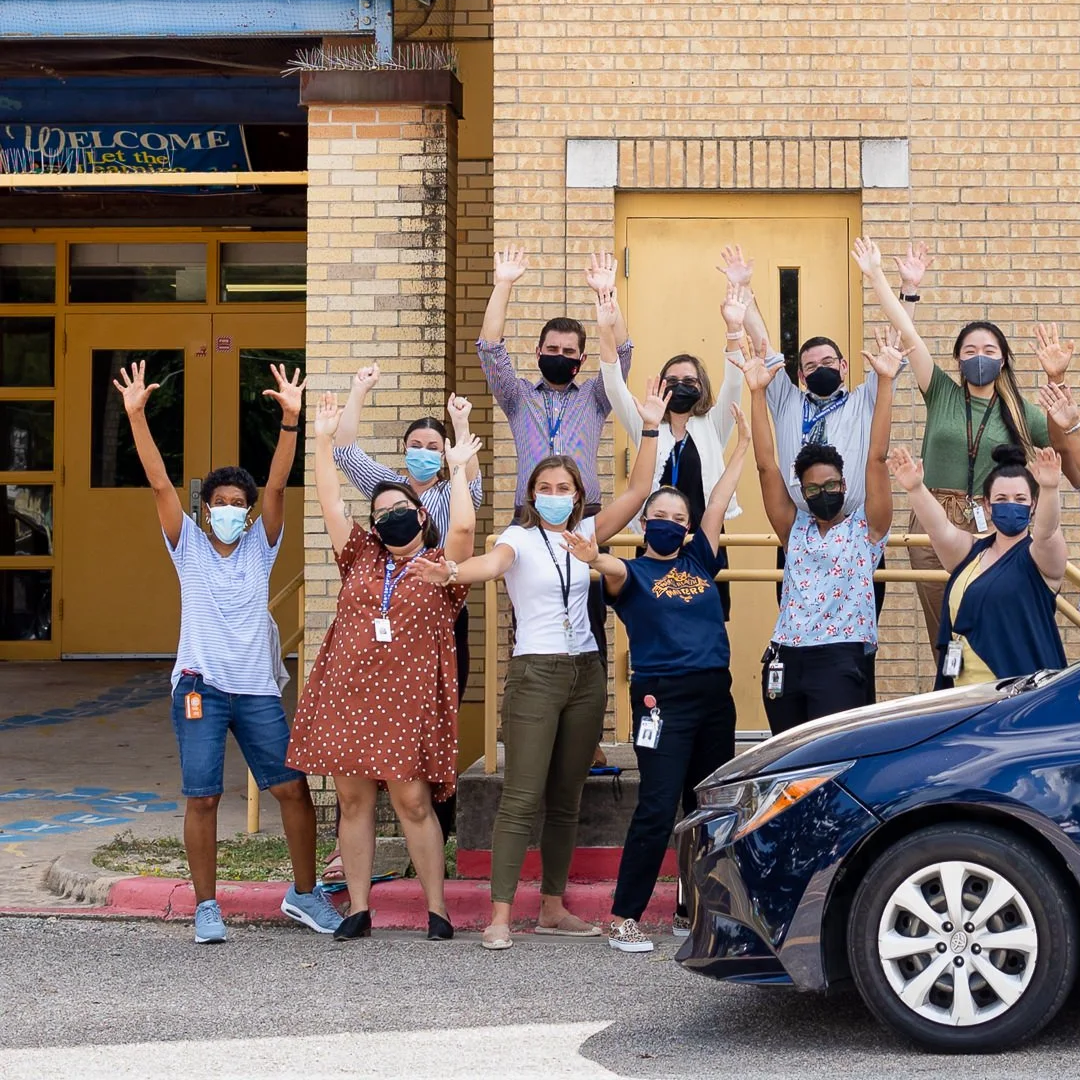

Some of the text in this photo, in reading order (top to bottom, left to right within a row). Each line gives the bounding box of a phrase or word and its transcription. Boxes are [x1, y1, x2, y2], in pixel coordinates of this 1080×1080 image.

[25, 125, 230, 158] WELCOME
[86, 150, 169, 165] Let the
